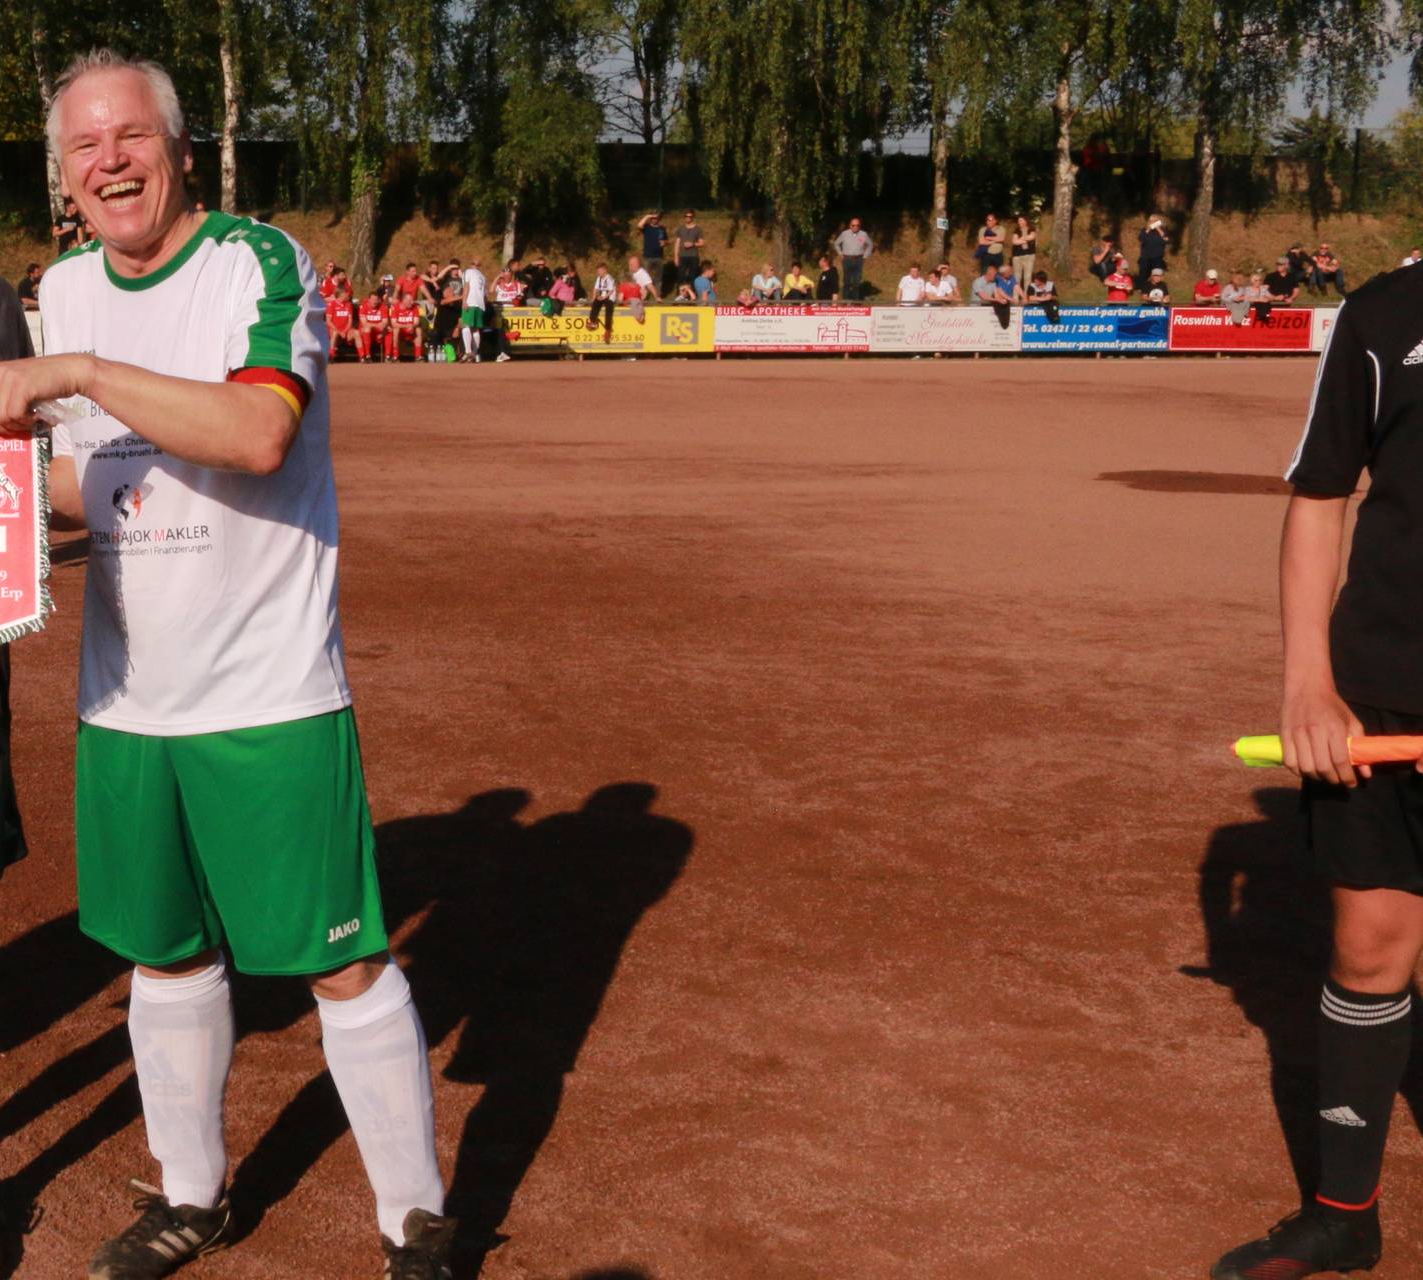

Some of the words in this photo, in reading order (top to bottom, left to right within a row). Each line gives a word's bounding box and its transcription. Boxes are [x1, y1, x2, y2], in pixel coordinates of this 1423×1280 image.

[717, 307, 806, 315] BURG-APOTHEKE
[1057, 307, 1138, 318] ersonal-partner
[1139, 307, 1166, 317] gmbh
[551, 318, 559, 329] &
[565, 318, 608, 329] SON
[1173, 315, 1221, 326] Roswitha
[1023, 324, 1038, 332] Tel.
[1040, 324, 1068, 333] 02421
[1078, 324, 1090, 332] 22
[1022, 340, 1168, 350] www.reimer-personal-partner.de
[1402, 357, 1423, 366] adi
[155, 525, 210, 543] MAKLER
[154, 544, 213, 557] Finanzierungen
[0, 587, 23, 602] Erp
[328, 918, 360, 943] JAKO
